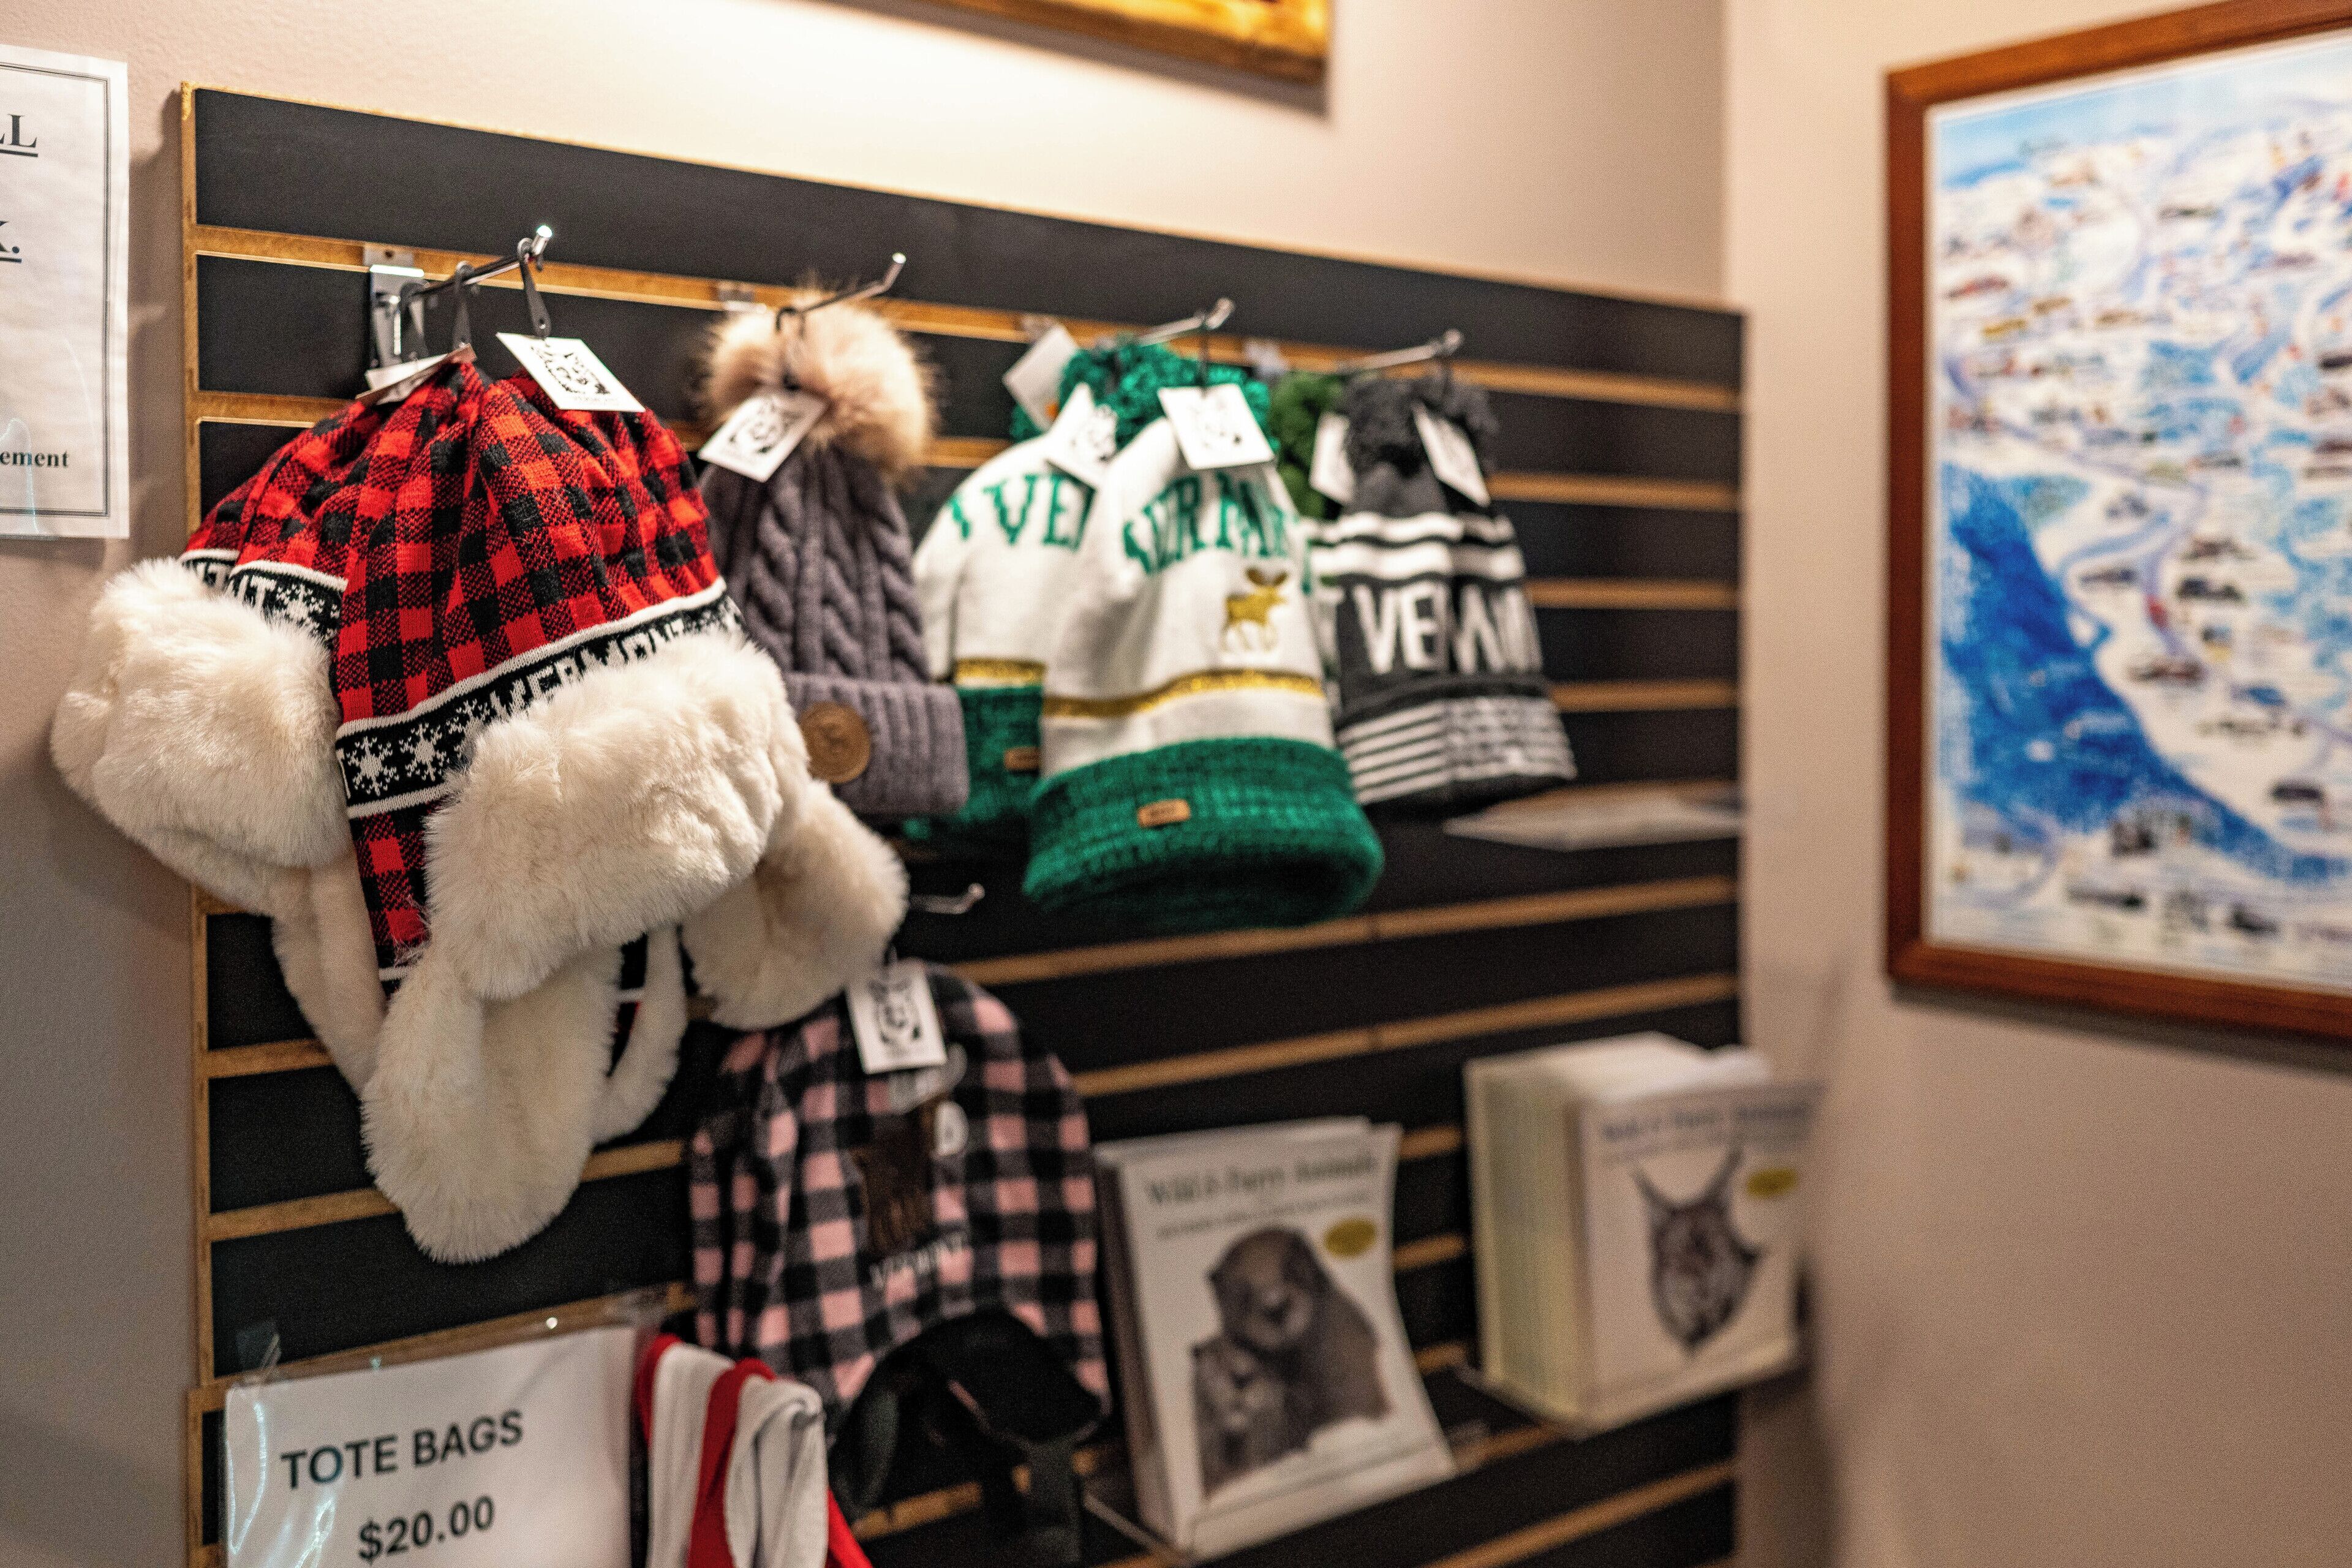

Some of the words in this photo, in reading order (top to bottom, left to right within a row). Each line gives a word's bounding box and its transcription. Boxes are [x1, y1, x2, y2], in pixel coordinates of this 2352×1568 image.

[0, 113, 37, 148] L
[0, 451, 69, 468] ement
[280, 1433, 399, 1490] TOTE
[412, 1409, 524, 1469] BAGS
[358, 1494, 495, 1566] $20.00
